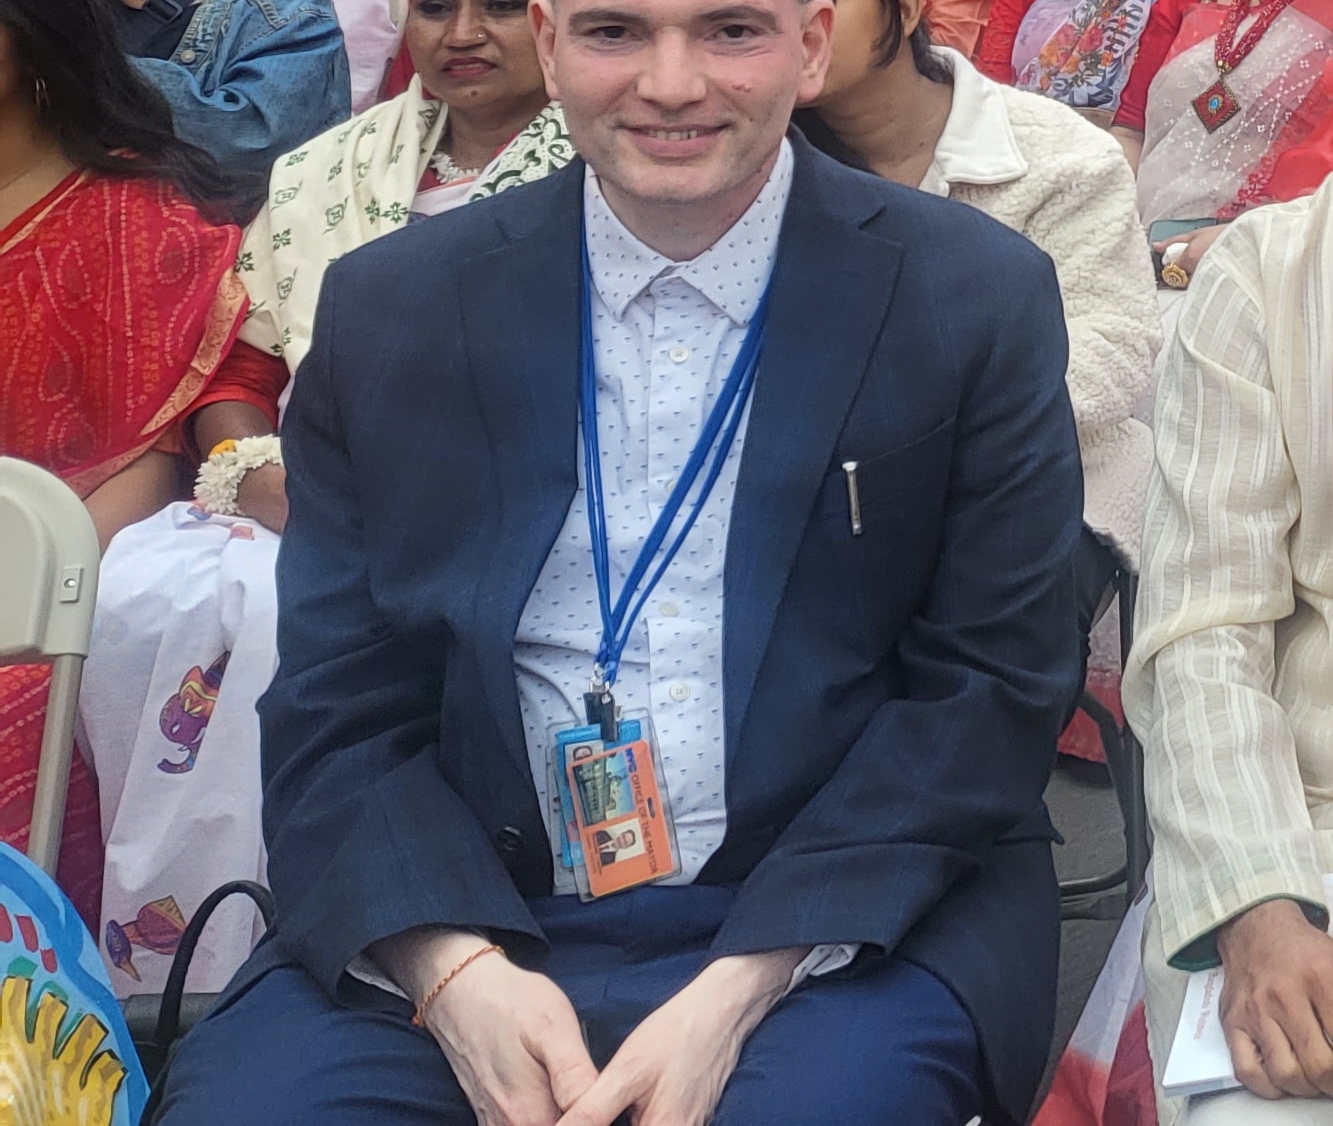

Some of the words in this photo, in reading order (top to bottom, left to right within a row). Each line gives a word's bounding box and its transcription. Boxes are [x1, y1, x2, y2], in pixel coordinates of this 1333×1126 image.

[631, 774, 645, 804] OFFICE
[637, 804, 648, 820] OF
[641, 821, 652, 838] THE
[646, 839, 658, 873] MAYOR
